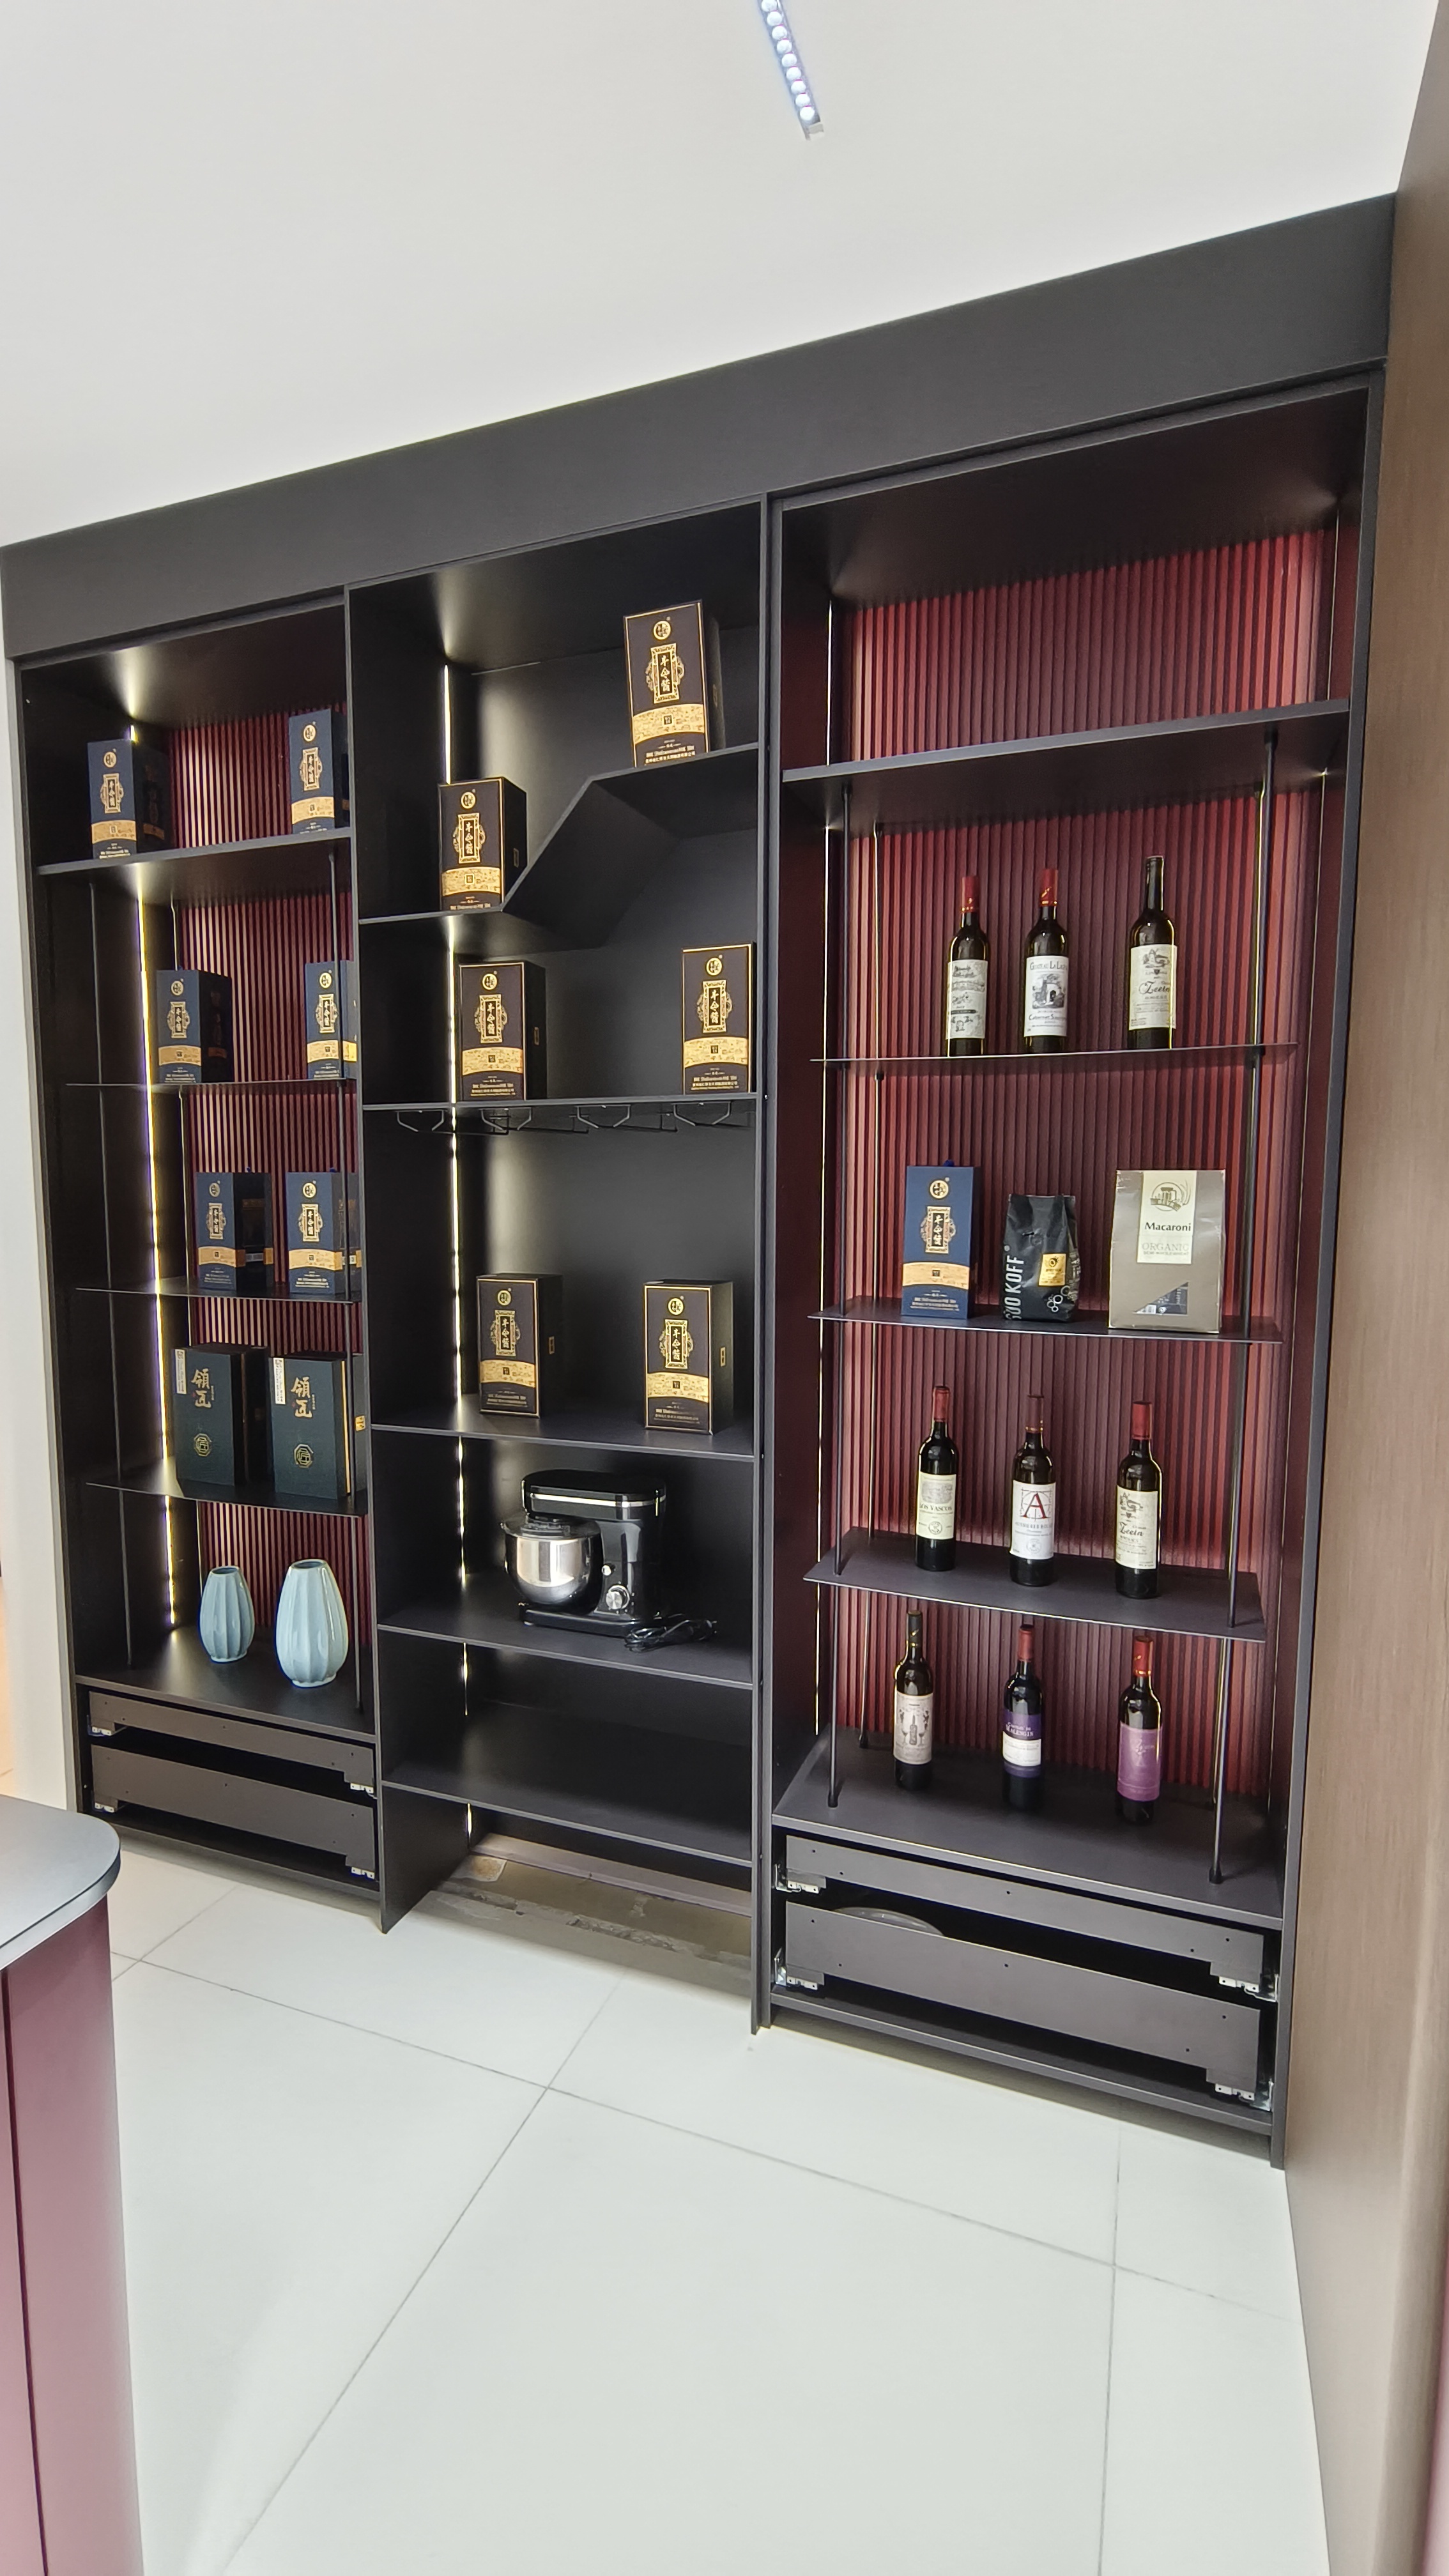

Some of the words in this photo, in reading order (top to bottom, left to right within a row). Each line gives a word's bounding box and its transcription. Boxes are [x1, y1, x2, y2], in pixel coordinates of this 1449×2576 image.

[1144, 1222, 1192, 1232] Macaroni
[1142, 1242, 1190, 1252] ORGANIC
[1005, 1255, 1024, 1294] KOFF
